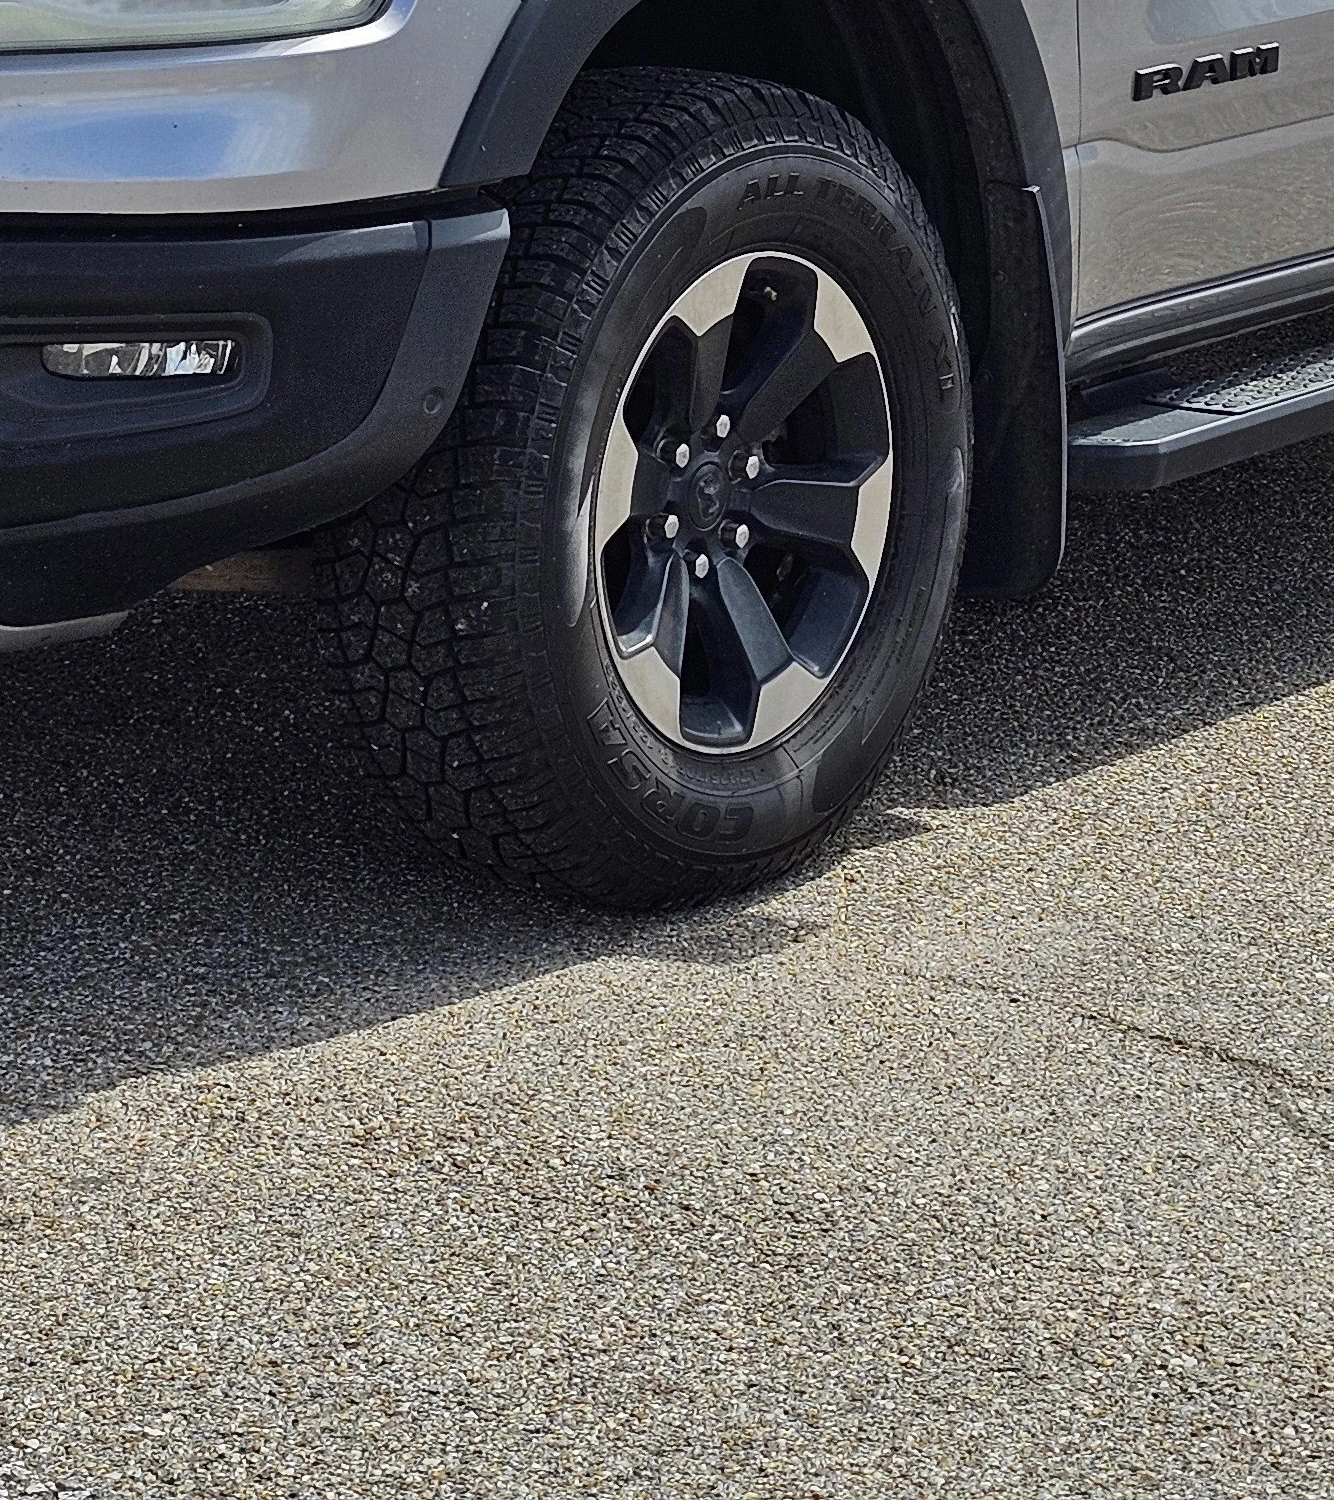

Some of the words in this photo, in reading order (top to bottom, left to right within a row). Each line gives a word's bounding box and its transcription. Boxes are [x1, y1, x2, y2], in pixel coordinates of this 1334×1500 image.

[1132, 41, 1280, 102] RAM
[737, 172, 804, 210] ALL
[587, 697, 755, 844] CORSA
